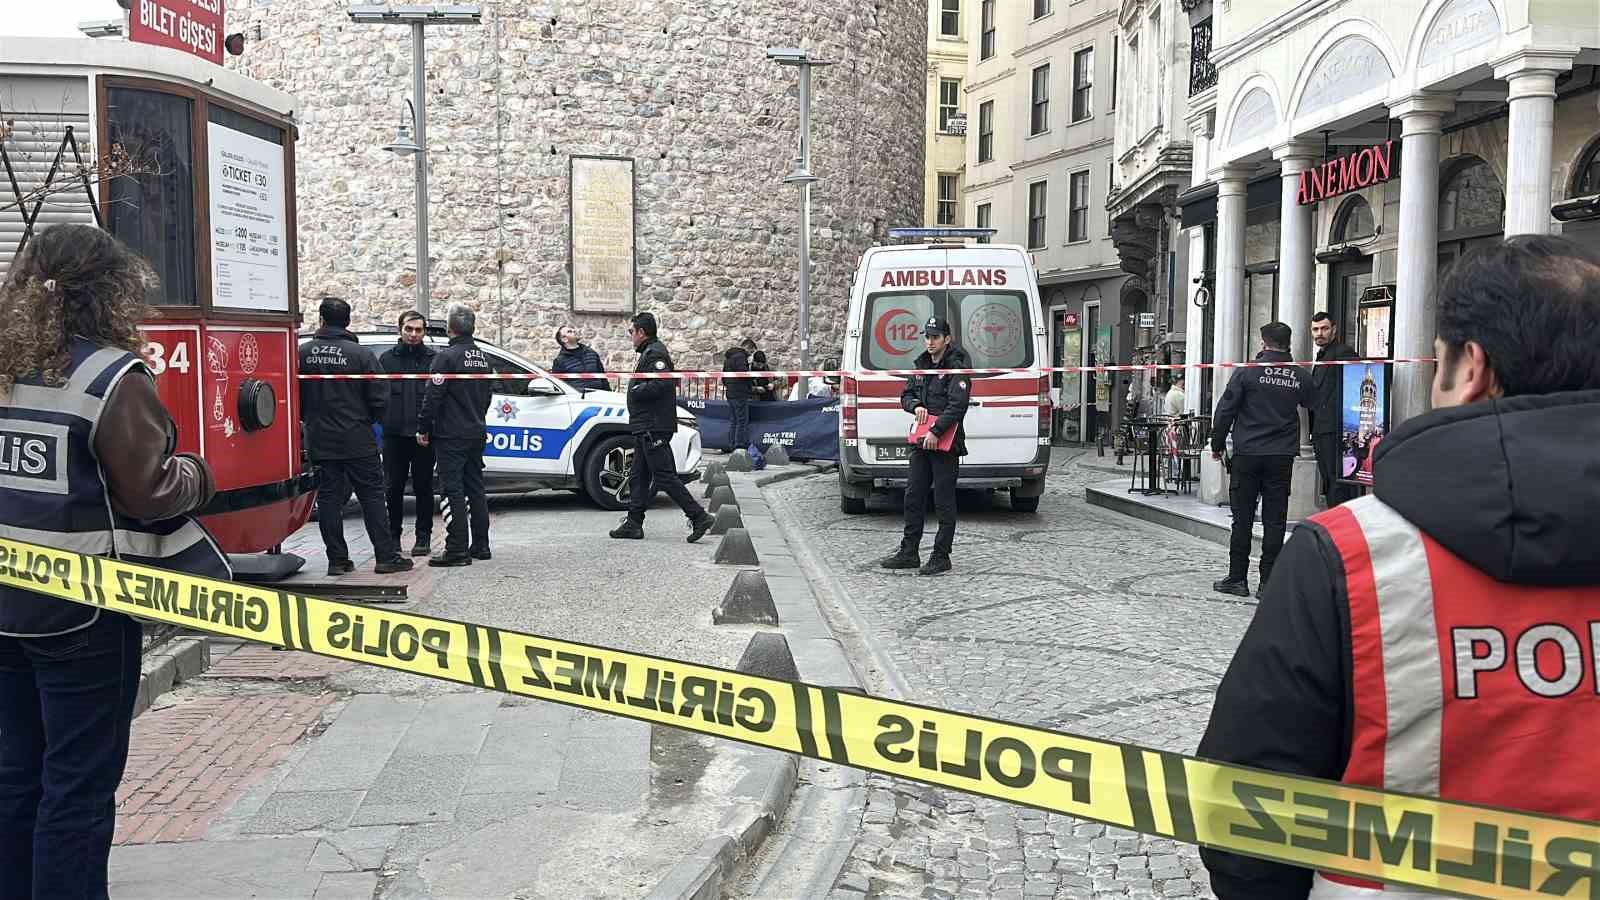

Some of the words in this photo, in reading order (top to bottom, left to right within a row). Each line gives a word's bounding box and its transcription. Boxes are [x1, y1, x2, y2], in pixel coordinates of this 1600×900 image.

[179, 11, 216, 54] GİŞESİ
[228, 165, 252, 183] TICKET
[1296, 140, 1392, 206] ANEMON
[881, 269, 1007, 287] AMBULANS
[888, 324, 918, 341] 112
[141, 341, 190, 375] 34
[879, 447, 889, 457] 34
